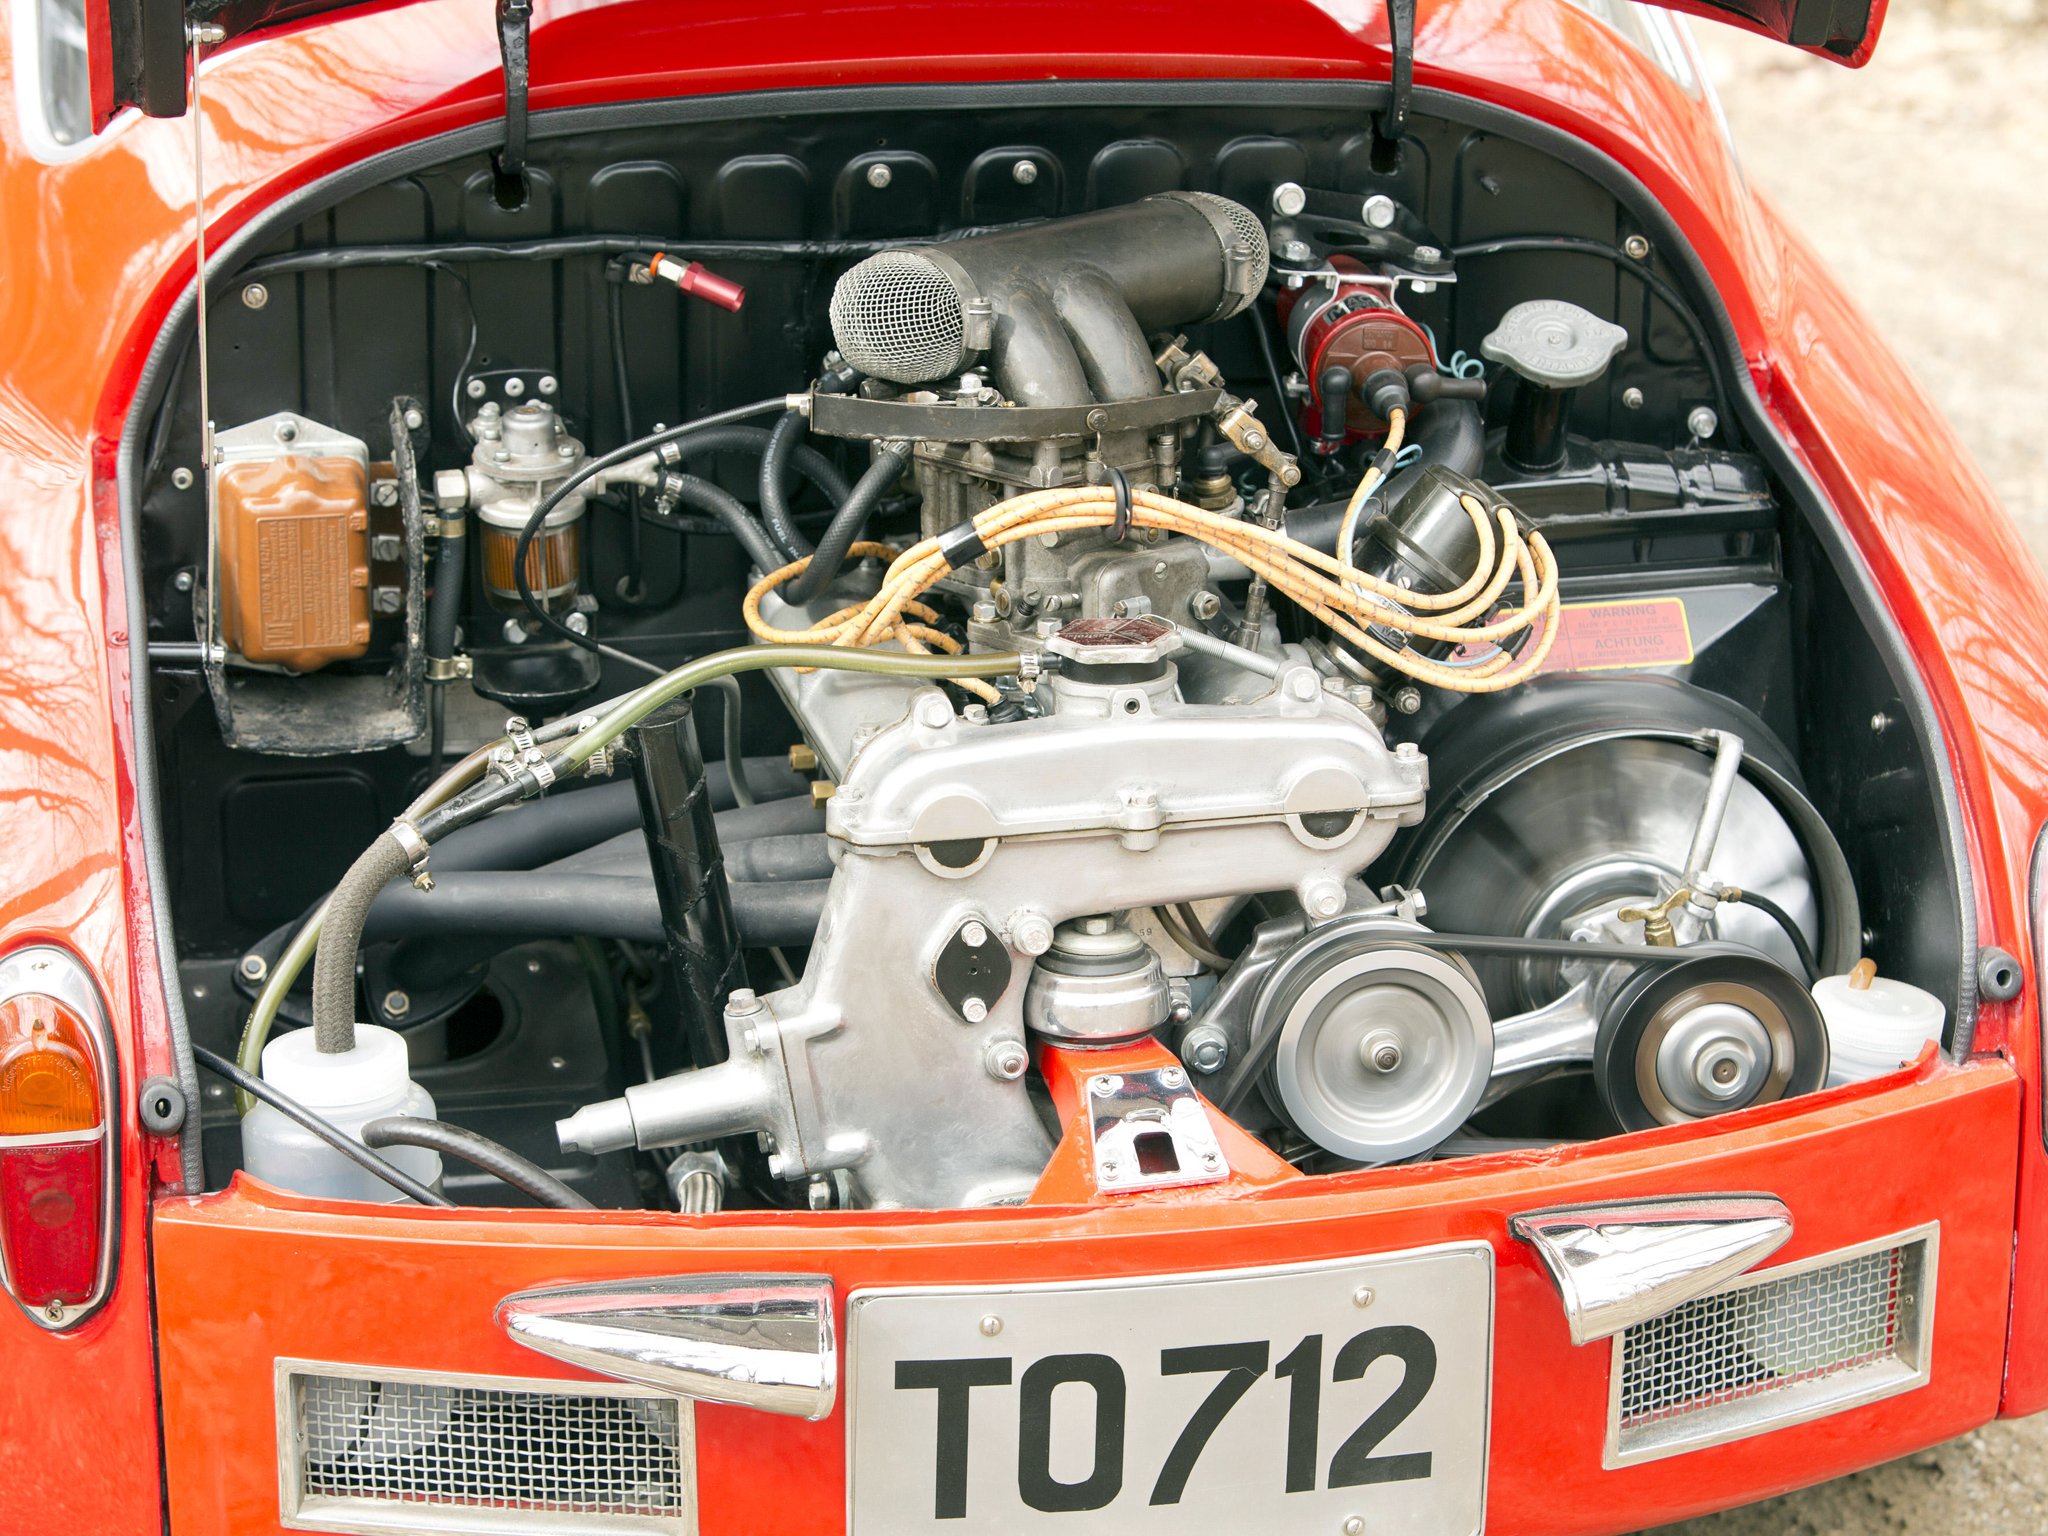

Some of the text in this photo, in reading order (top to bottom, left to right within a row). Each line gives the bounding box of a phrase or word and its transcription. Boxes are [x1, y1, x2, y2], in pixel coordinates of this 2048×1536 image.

[771, 518, 786, 544] FUEL
[1589, 604, 1657, 619] WARNING
[1594, 634, 1665, 650] ACHTUNG
